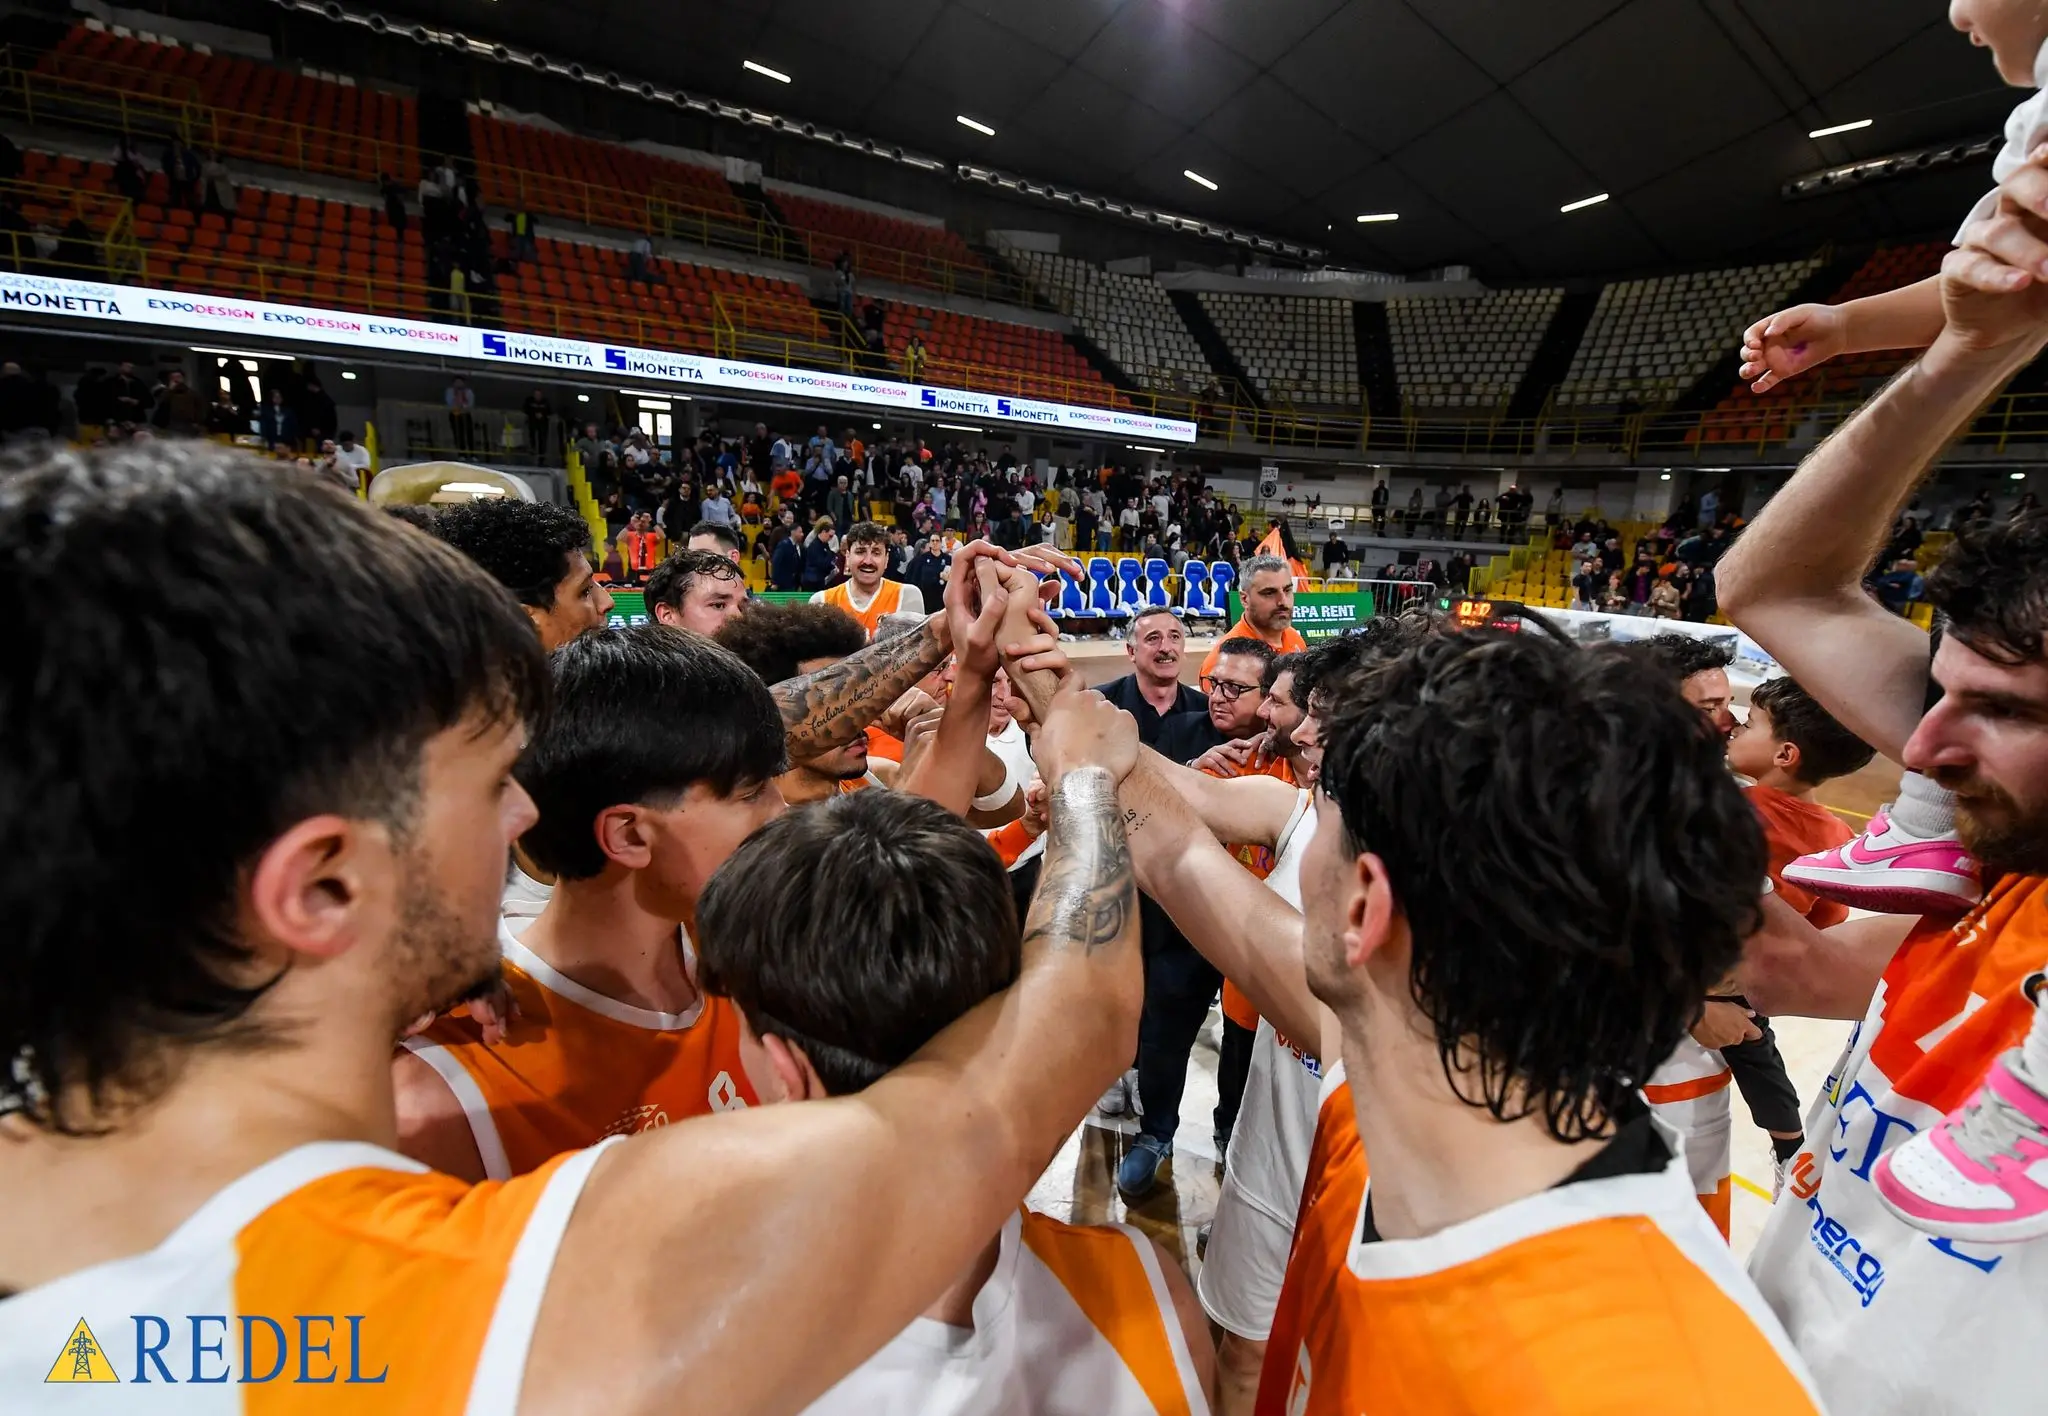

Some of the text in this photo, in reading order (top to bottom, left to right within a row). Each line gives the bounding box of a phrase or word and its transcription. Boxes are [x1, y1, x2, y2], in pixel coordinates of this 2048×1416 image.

[3, 289, 122, 316] MONETTA
[148, 298, 460, 343] EXPODESIGN EXPODESIGN EXPODESIGN
[719, 366, 907, 397] EXPODESIGN EXPODESIGN EXPODESIGN
[1069, 411, 1192, 433] EXPODESIGN EXPODESIGN EXPODESIGN
[1292, 604, 1356, 618] RPA RENT
